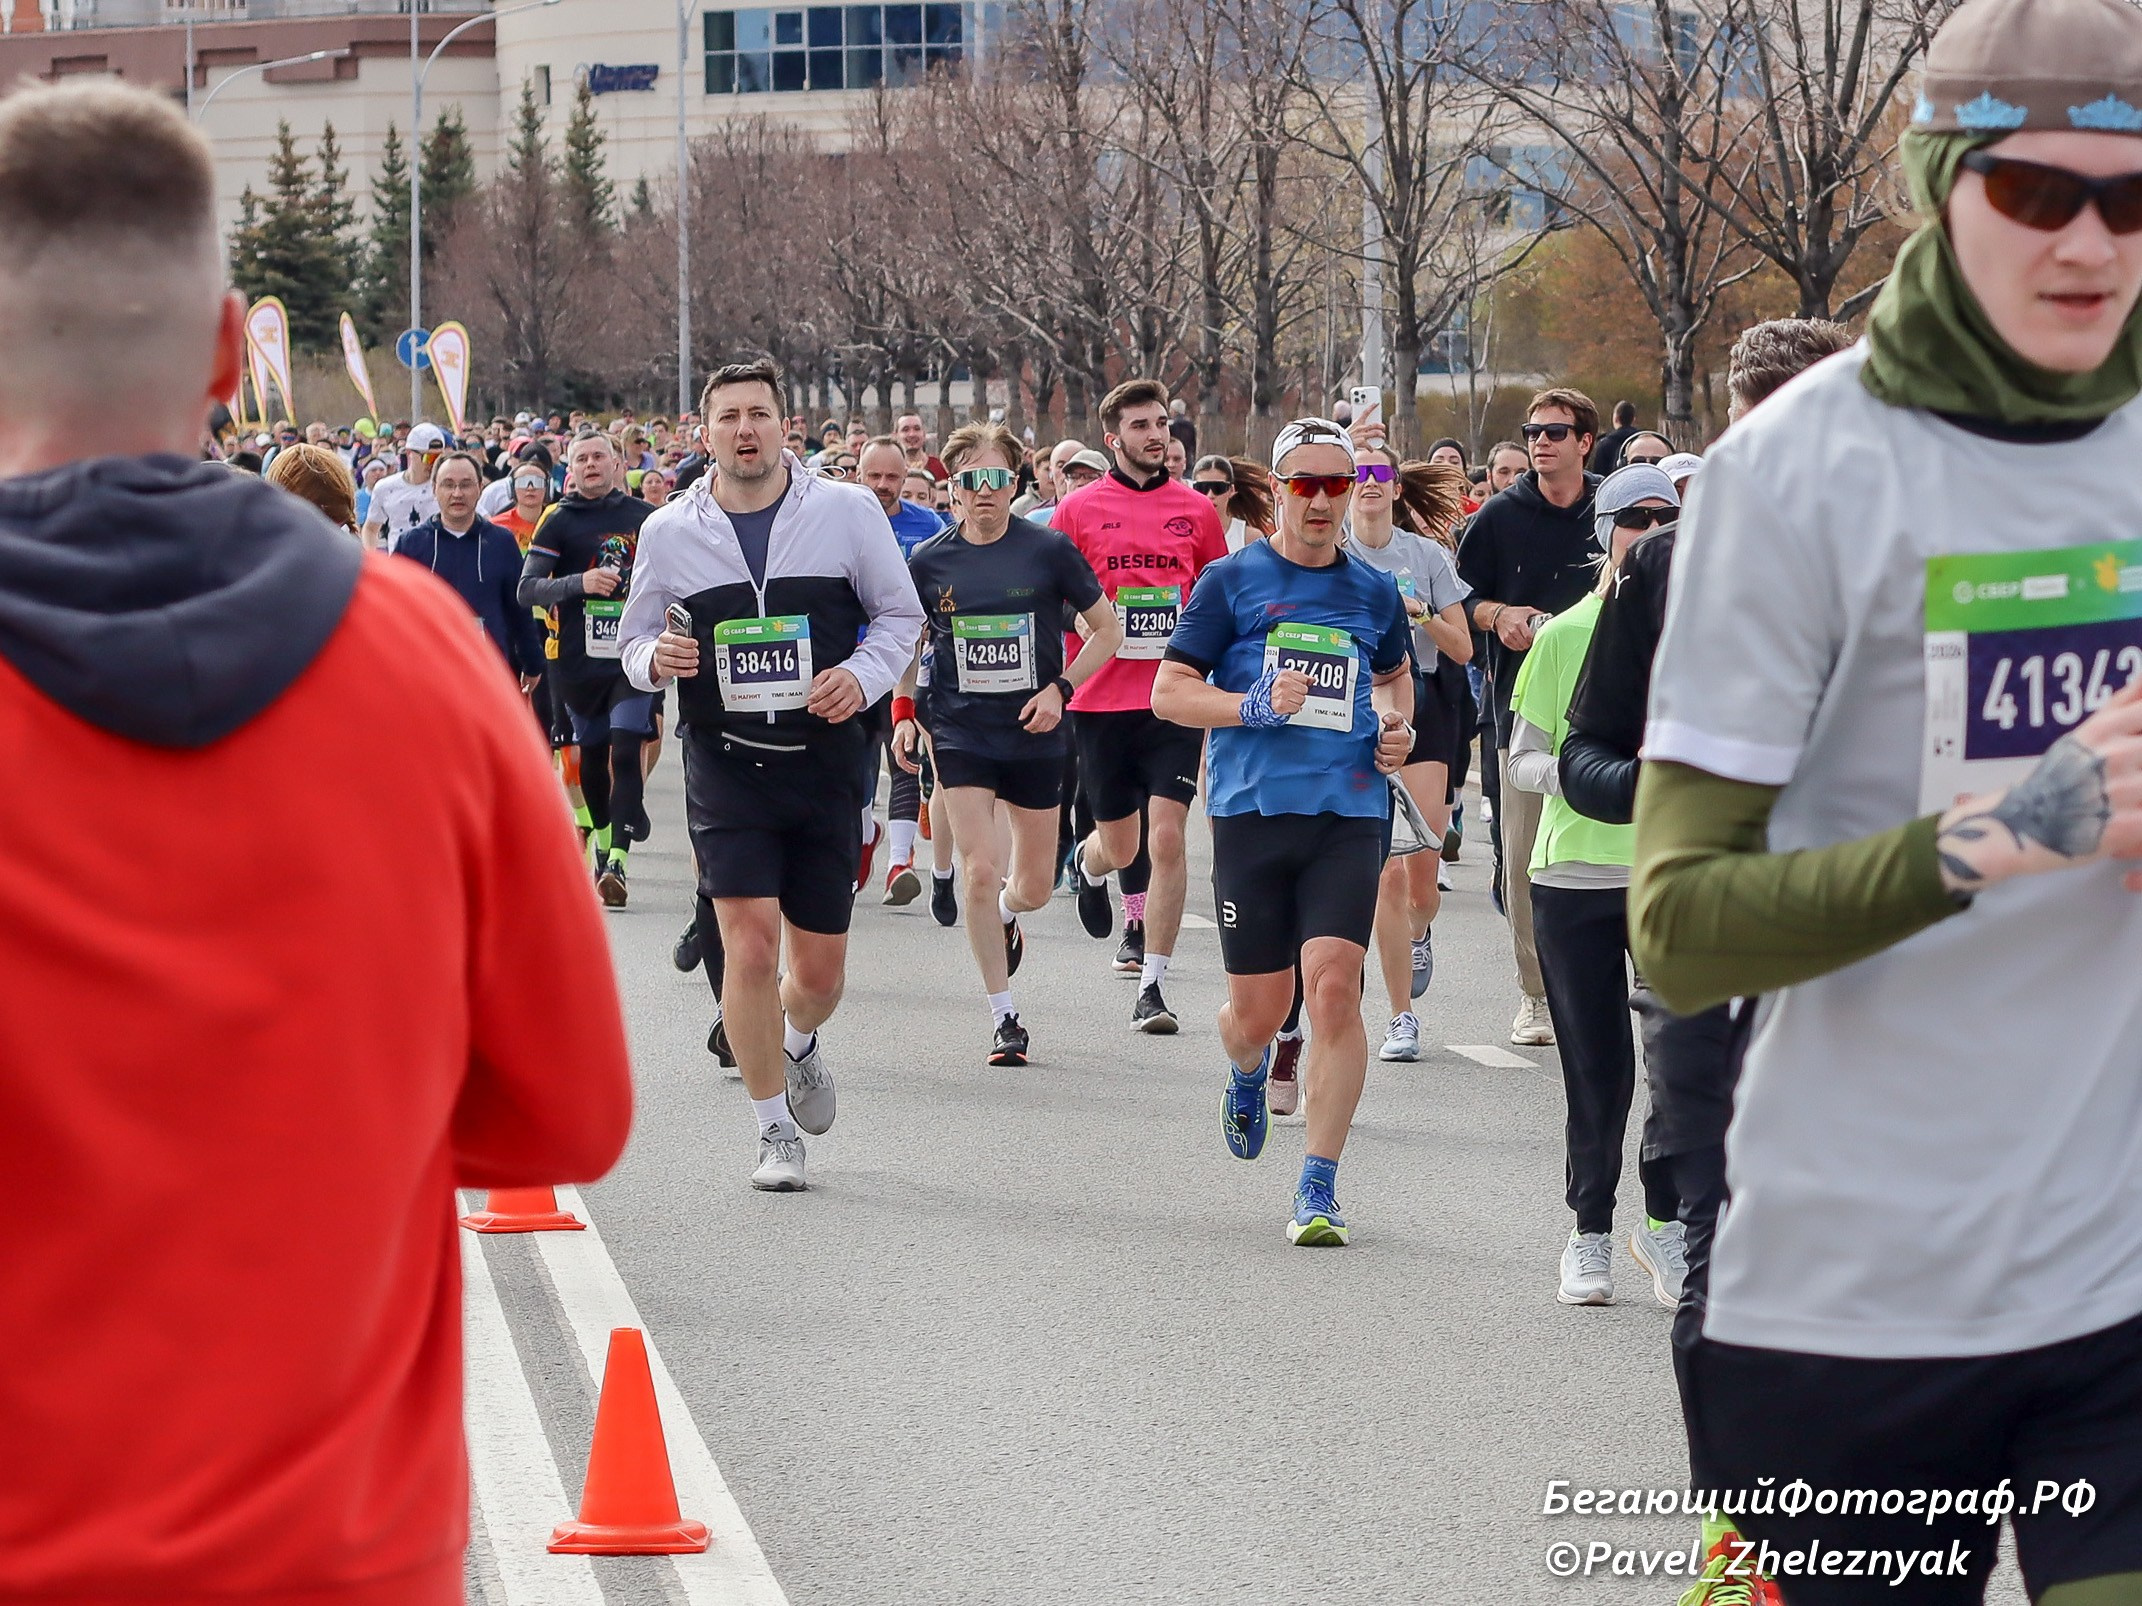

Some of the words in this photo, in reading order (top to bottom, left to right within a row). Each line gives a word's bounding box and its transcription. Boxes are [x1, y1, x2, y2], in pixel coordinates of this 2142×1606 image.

[595, 620, 620, 635] 346
[1130, 612, 1174, 631] 32306
[736, 648, 795, 675] 38416
[967, 643, 1019, 665] 42848
[719, 658, 727, 670] D
